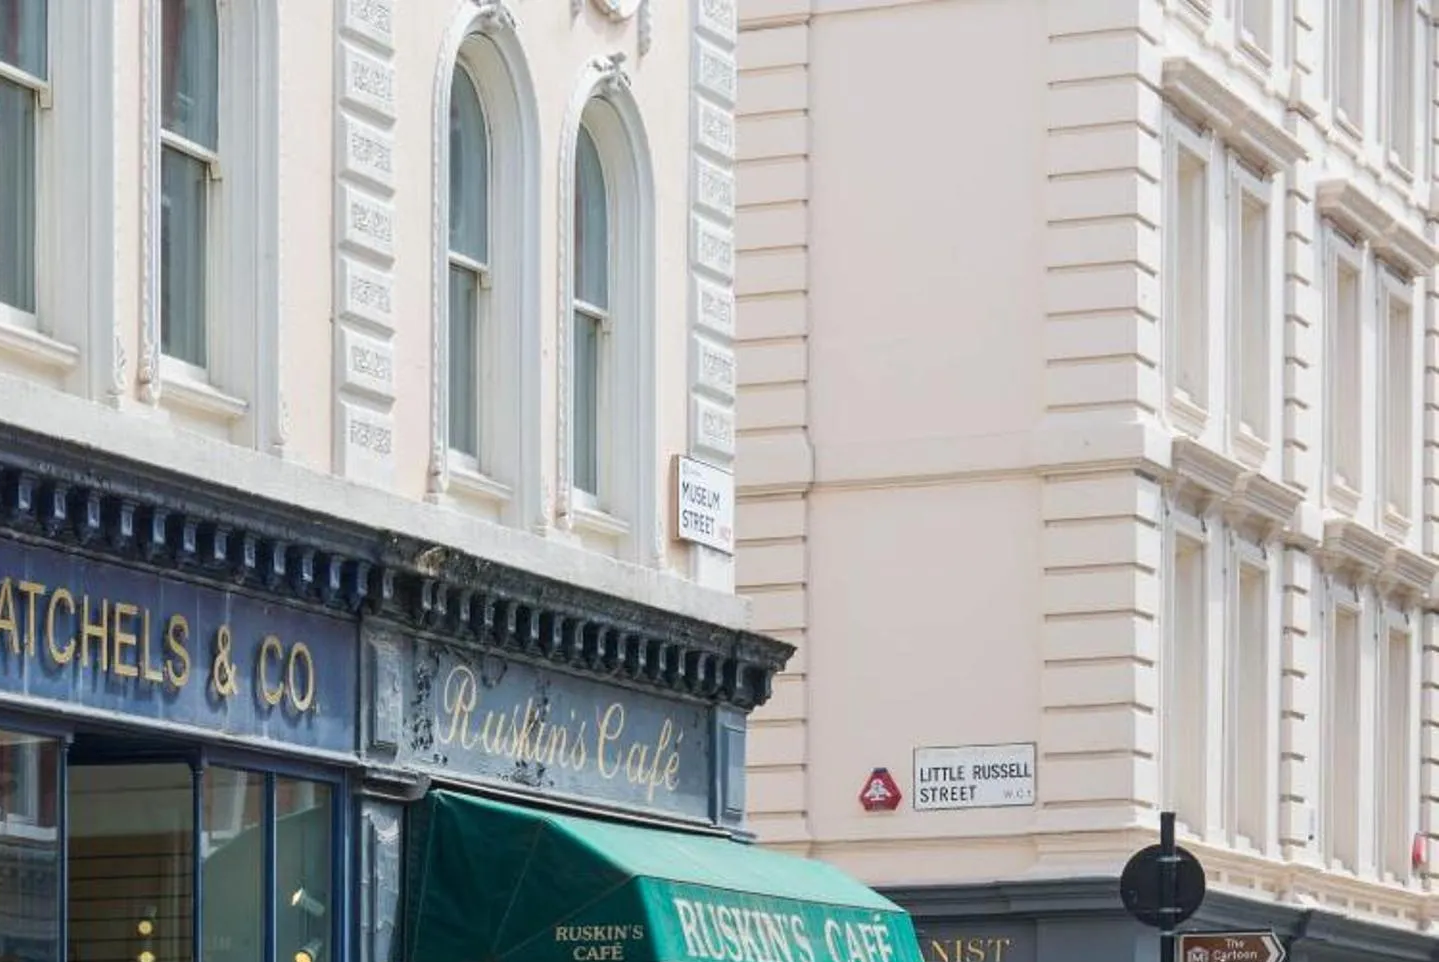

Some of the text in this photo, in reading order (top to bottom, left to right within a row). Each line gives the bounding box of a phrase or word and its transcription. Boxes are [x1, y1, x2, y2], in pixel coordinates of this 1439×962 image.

[681, 509, 715, 537] STREET
[214, 624, 239, 695] &
[259, 634, 315, 711] CO
[436, 665, 684, 803] Ruskin's Café
[919, 762, 1031, 783] LITTLE RUSSELL
[919, 785, 977, 804] STREET
[555, 924, 644, 961] RUSKIN'S CAFÉ
[1224, 937, 1246, 949] The
[1212, 949, 1258, 961] Cartoon
